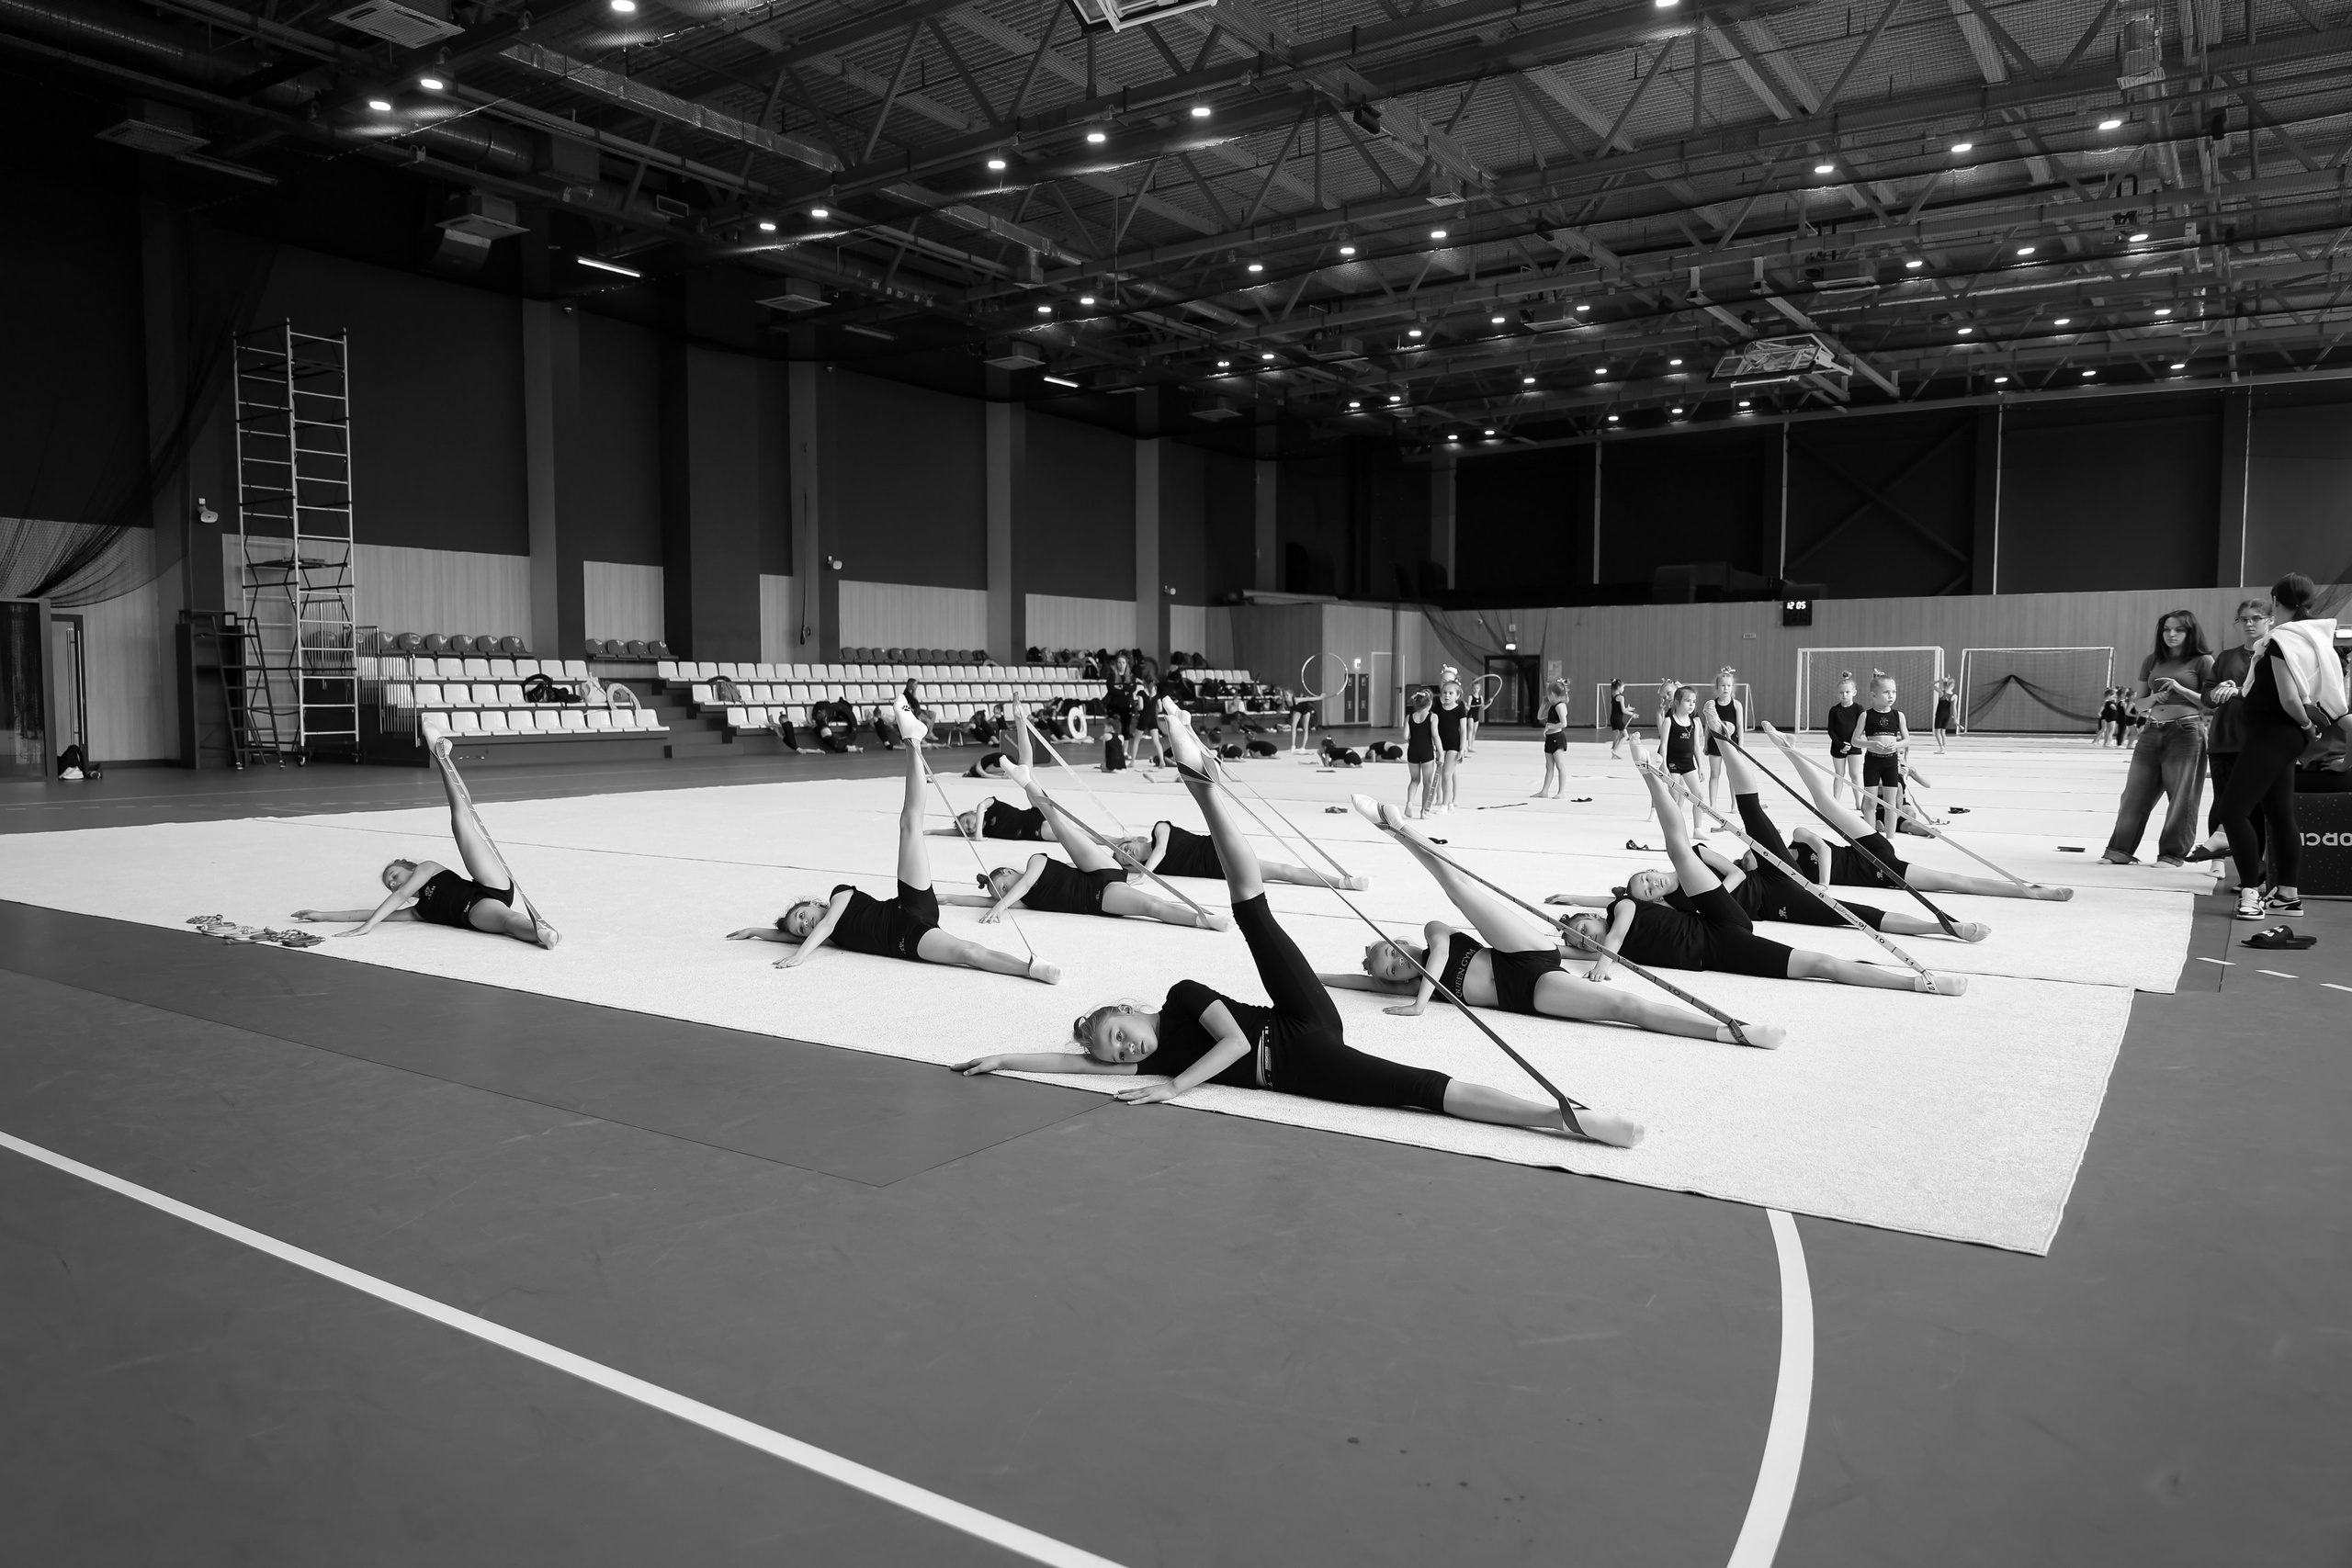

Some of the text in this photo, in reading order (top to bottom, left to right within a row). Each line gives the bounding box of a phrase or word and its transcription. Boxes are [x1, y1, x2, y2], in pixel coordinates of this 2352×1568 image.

[1874, 933, 1885, 944] 10
[1904, 956, 1915, 966] 11
[1455, 948, 1476, 998] QUEEN GYM
[1668, 985, 1680, 996] 10
